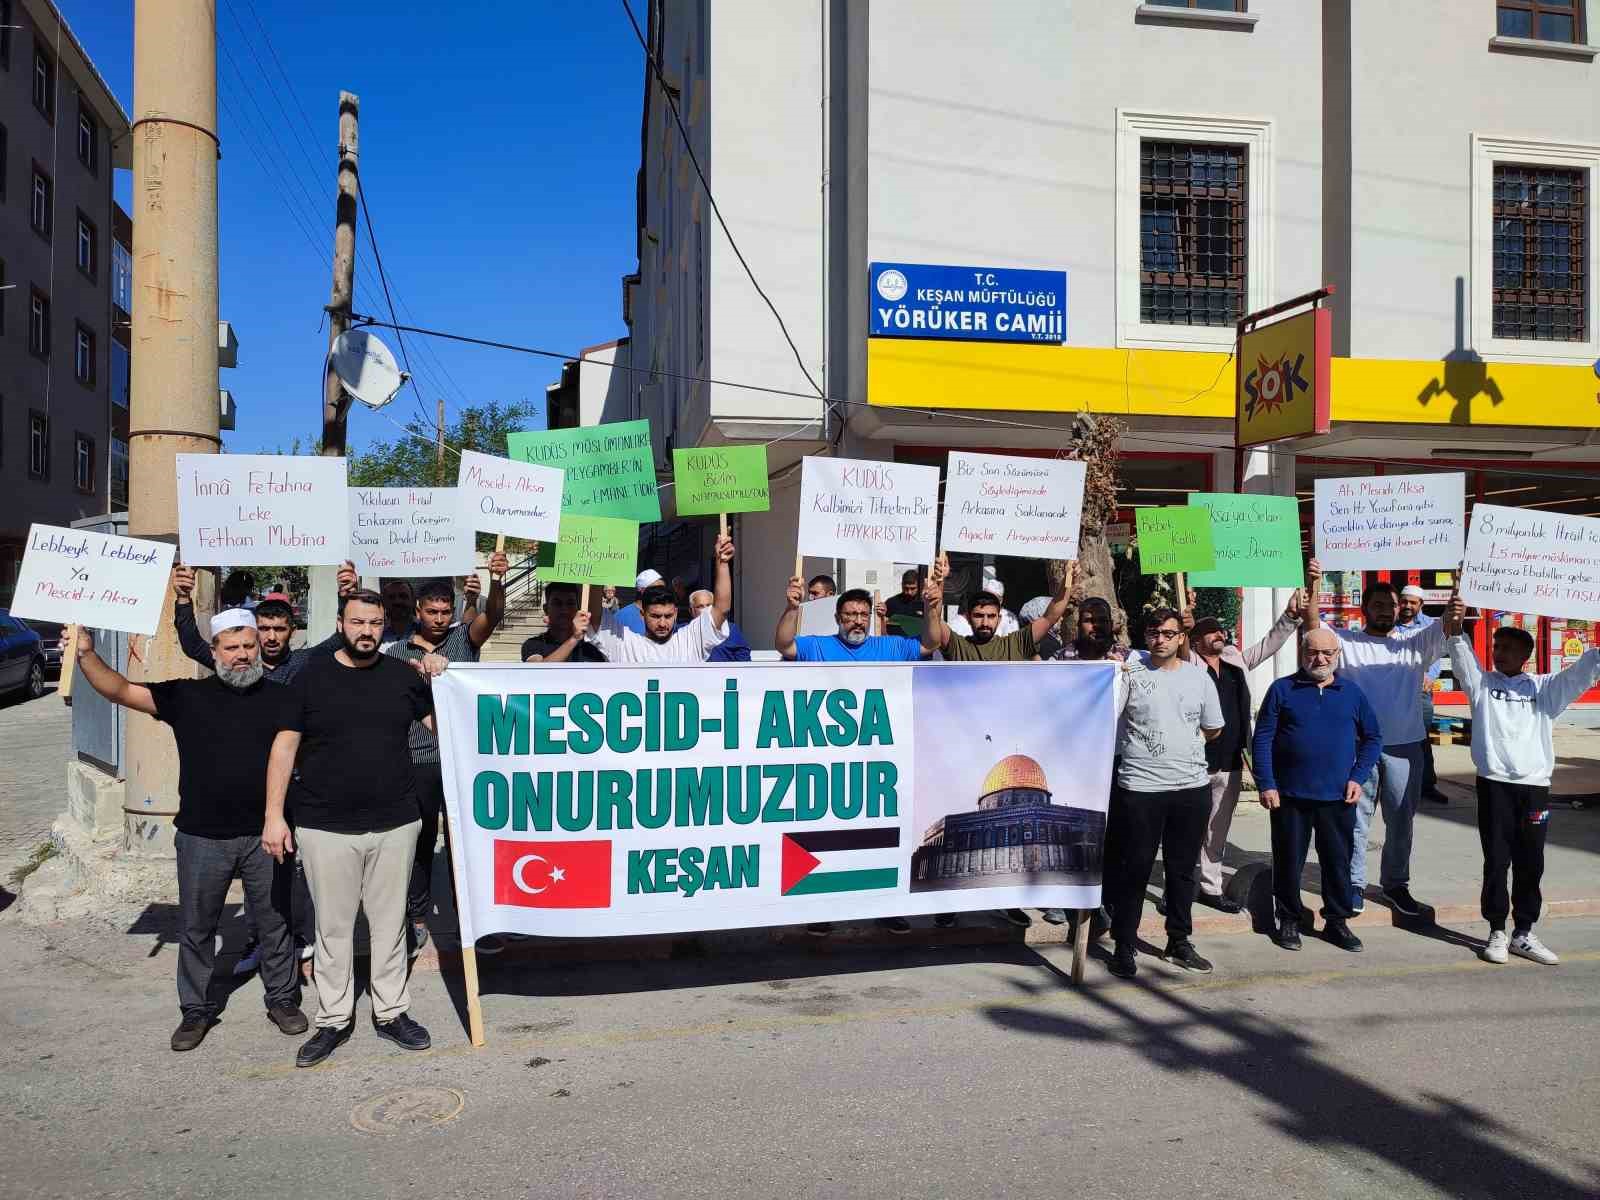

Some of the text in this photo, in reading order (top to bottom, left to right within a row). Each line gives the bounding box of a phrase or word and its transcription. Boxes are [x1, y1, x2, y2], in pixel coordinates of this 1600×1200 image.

[974, 273, 998, 286] T.C.
[917, 288, 1056, 307] KEŞAN MÜFTÜLÜĞÜ
[878, 304, 1062, 334] YÖRÜKER CAMİİ
[842, 464, 895, 490] KUDÜS
[957, 460, 975, 476] Biz
[981, 462, 1000, 476] Son
[249, 471, 313, 497] Fetahna
[516, 475, 545, 493] Aksa
[1338, 483, 1354, 497] Ah
[1398, 480, 1425, 495] Aksa
[238, 505, 273, 522] Leke
[812, 494, 863, 514] Kalbimizi
[912, 497, 933, 516] Bir
[1014, 503, 1069, 518] Saklanacak
[1330, 501, 1349, 516] Sen
[1369, 499, 1397, 513] Yusuf
[1322, 519, 1365, 535] Güzeldin
[1480, 512, 1494, 535] 8
[1495, 520, 1545, 540] milyonluk
[198, 527, 255, 548] Fethan
[352, 530, 380, 545] Sana
[389, 530, 418, 545] Devlet
[1374, 537, 1392, 552] gibi
[1395, 535, 1426, 548] ihanet
[32, 533, 160, 565] Lebbeyk Lebbeyk
[1511, 548, 1539, 561] milyar
[71, 567, 89, 582] Ya
[35, 581, 139, 606] Mescid-i Aksa
[1504, 582, 1527, 595] değil
[477, 678, 894, 756] MESCİD-İ AKSA
[473, 760, 899, 832] ONURUMUZDUR
[627, 844, 760, 898] KEŞAN
